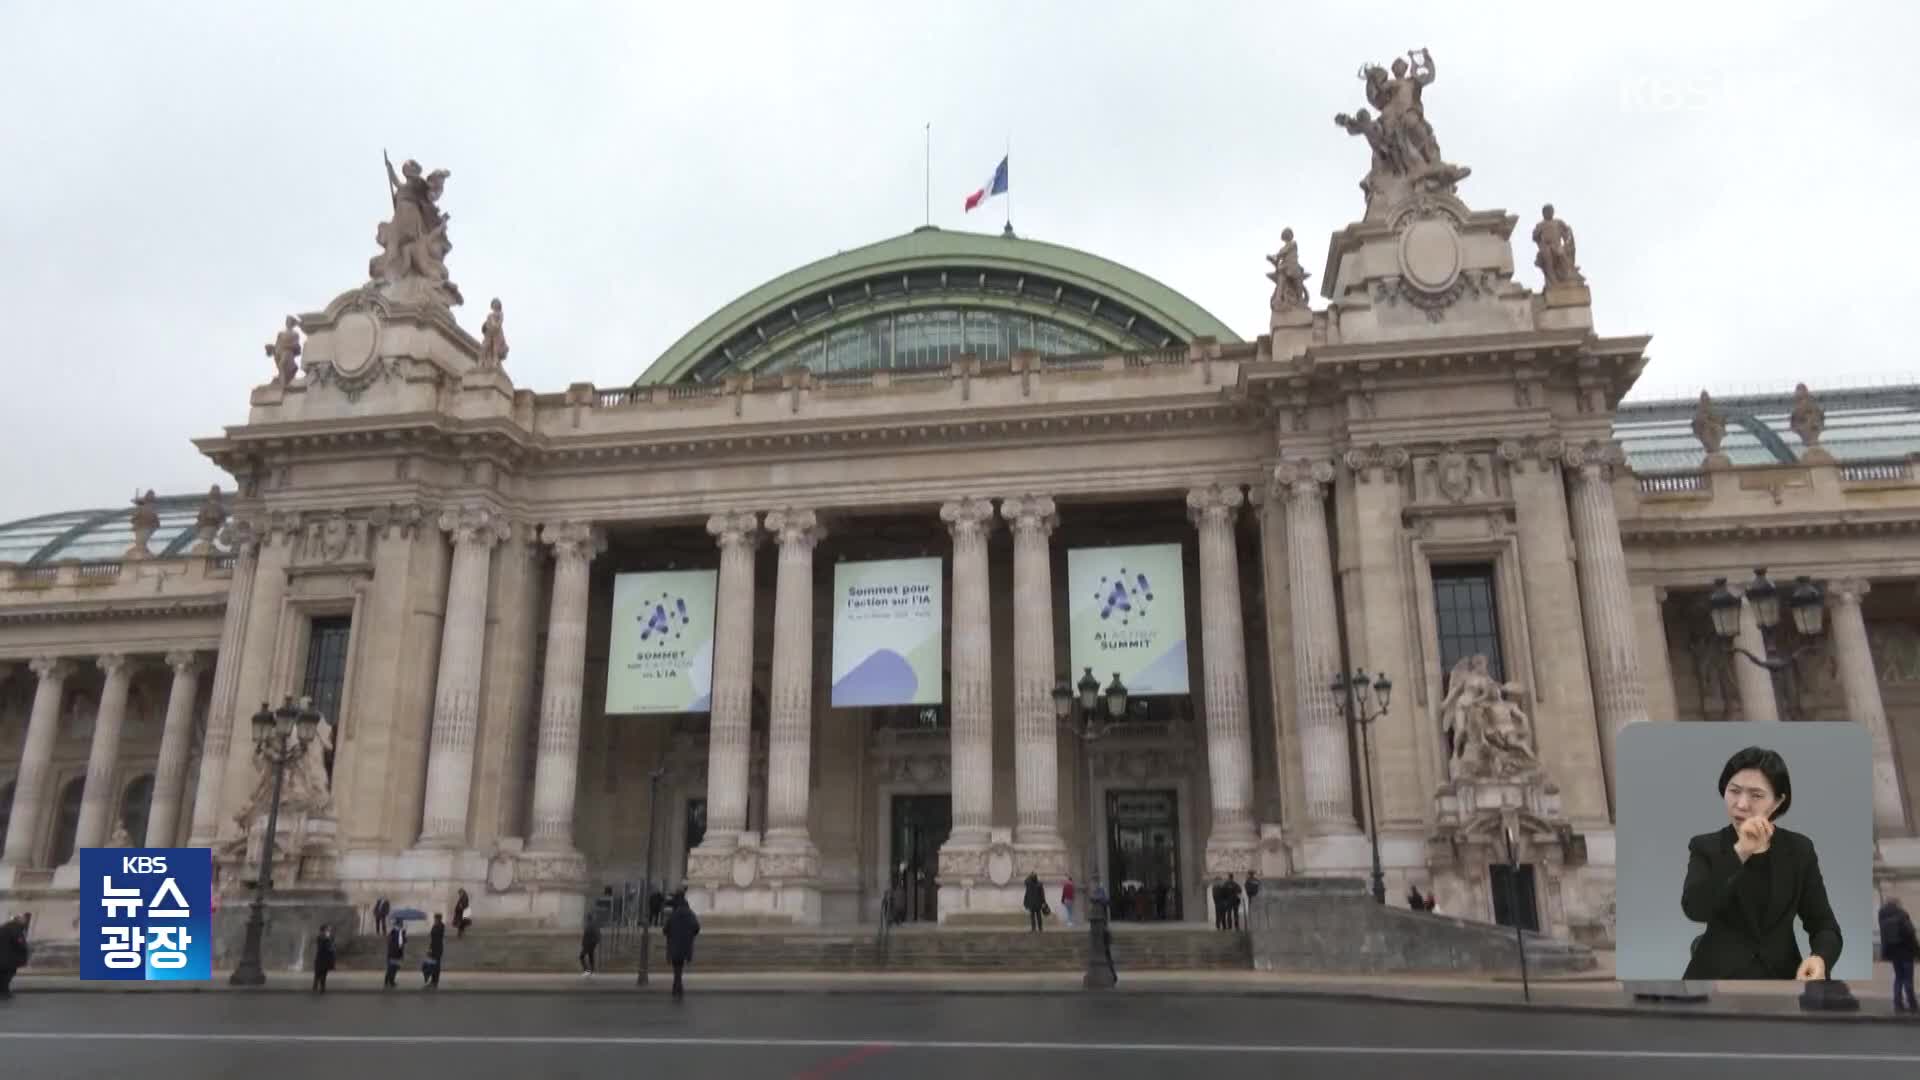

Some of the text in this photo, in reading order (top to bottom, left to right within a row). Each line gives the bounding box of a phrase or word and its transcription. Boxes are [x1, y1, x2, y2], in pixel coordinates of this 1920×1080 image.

[848, 584, 930, 597] Sommet pour
[848, 594, 931, 608] l'action sur l'IA
[1094, 632, 1107, 641] AI
[1101, 640, 1151, 650] SUMMIT
[636, 650, 686, 661] SOMMET
